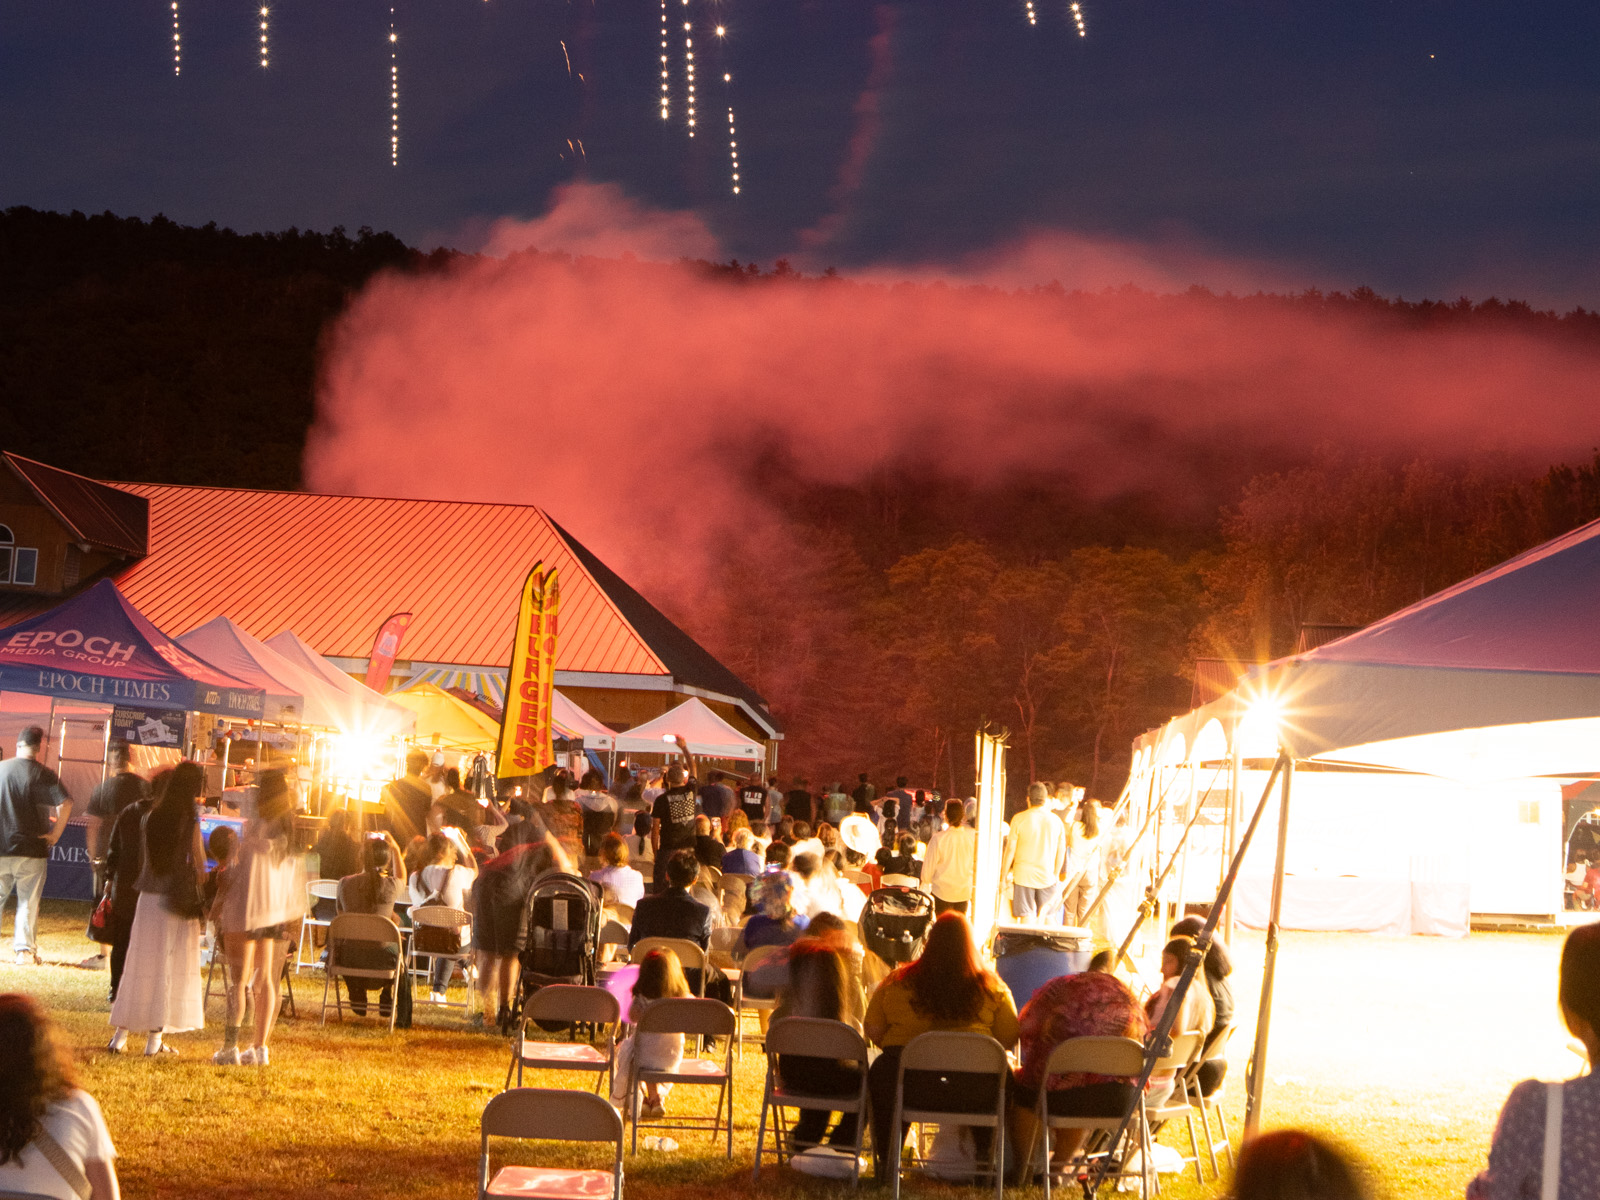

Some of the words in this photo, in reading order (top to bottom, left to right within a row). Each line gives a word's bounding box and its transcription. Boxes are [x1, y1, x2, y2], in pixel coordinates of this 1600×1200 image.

[7, 629, 137, 661] EPOCH
[0, 647, 56, 656] MEDIA
[62, 649, 126, 668] GROUP
[38, 671, 105, 695] EPOCH
[110, 679, 171, 701] TIMES
[115, 710, 145, 720] SUBSCRIBE
[48, 846, 93, 864] IMES
